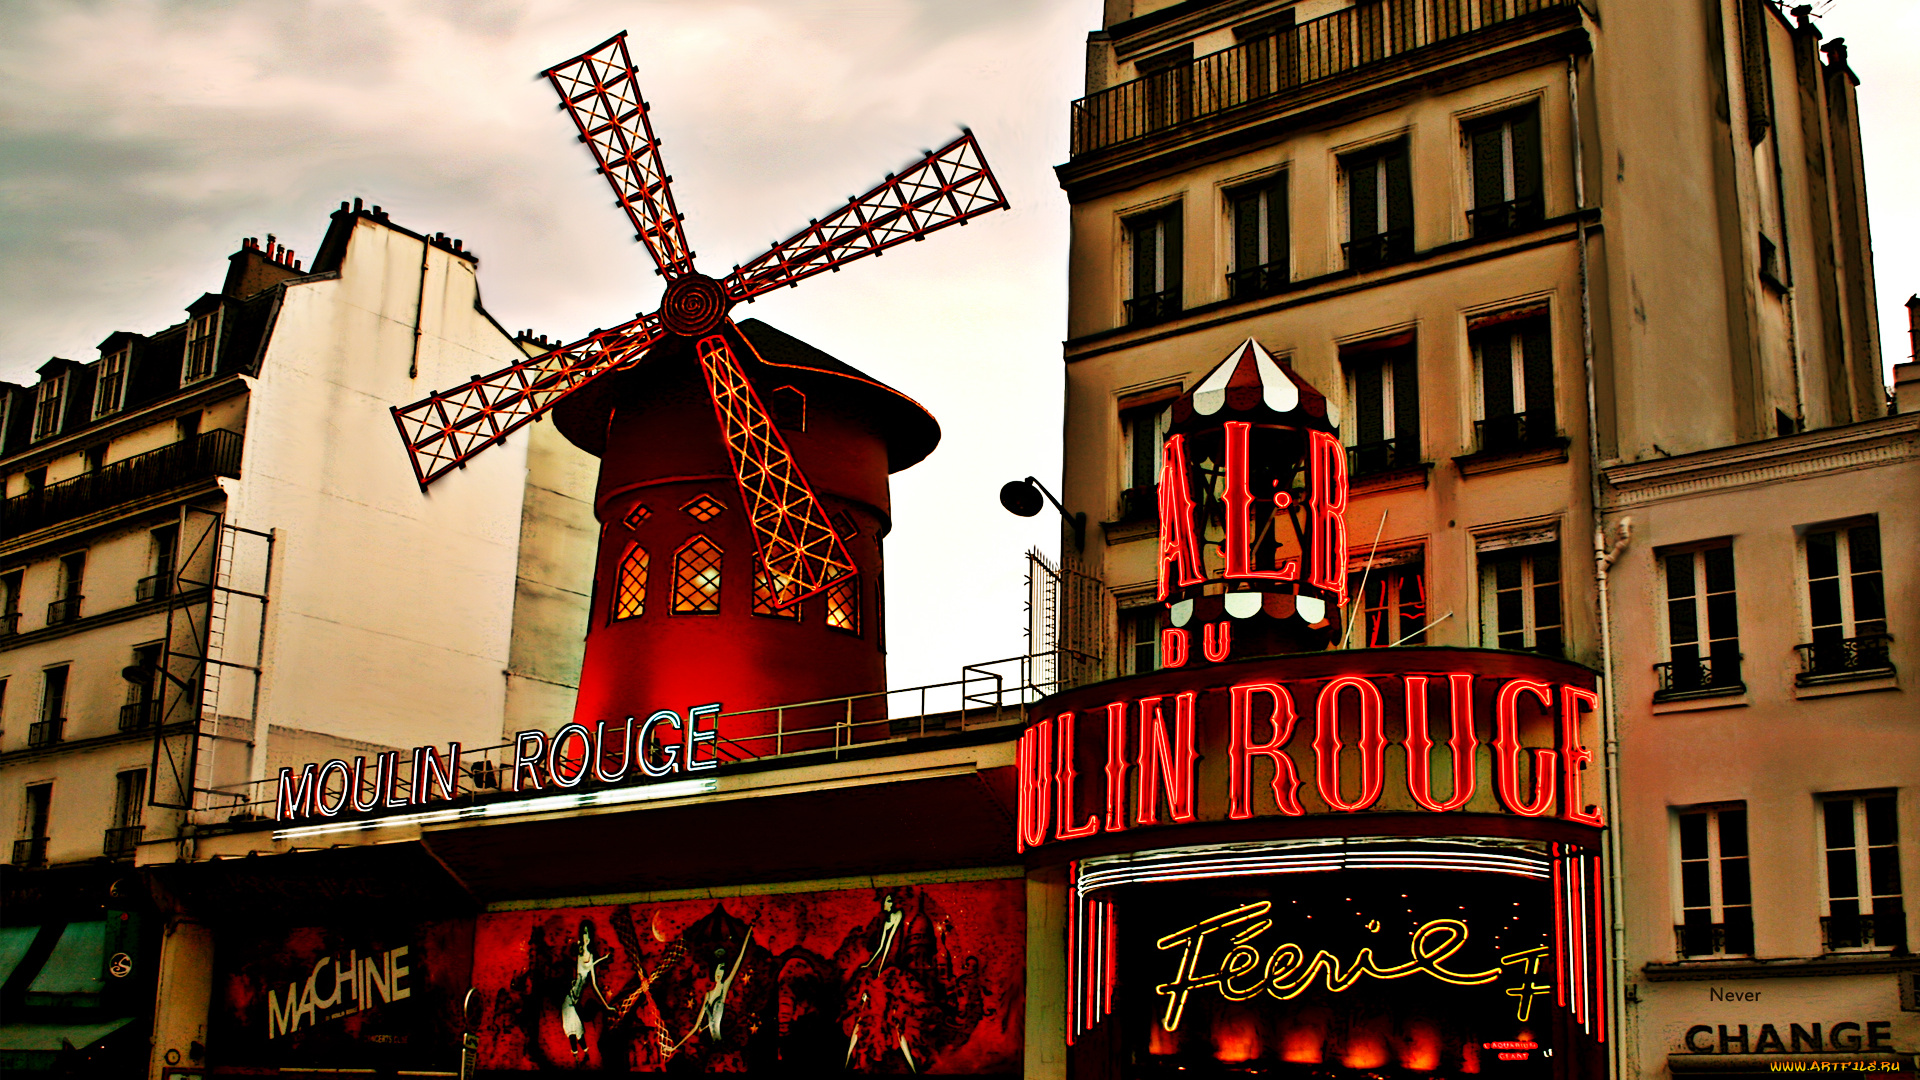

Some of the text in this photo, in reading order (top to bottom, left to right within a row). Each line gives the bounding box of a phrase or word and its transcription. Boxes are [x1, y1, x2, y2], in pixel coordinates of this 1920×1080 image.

[1162, 621, 1231, 668] DU
[275, 702, 722, 823] MOULIN ROUGE
[1016, 673, 1606, 853] ULIN ROUGE
[268, 945, 411, 1039] MACHINE
[1710, 986, 1762, 1002] Never
[1684, 1020, 1896, 1054] CHANGE
